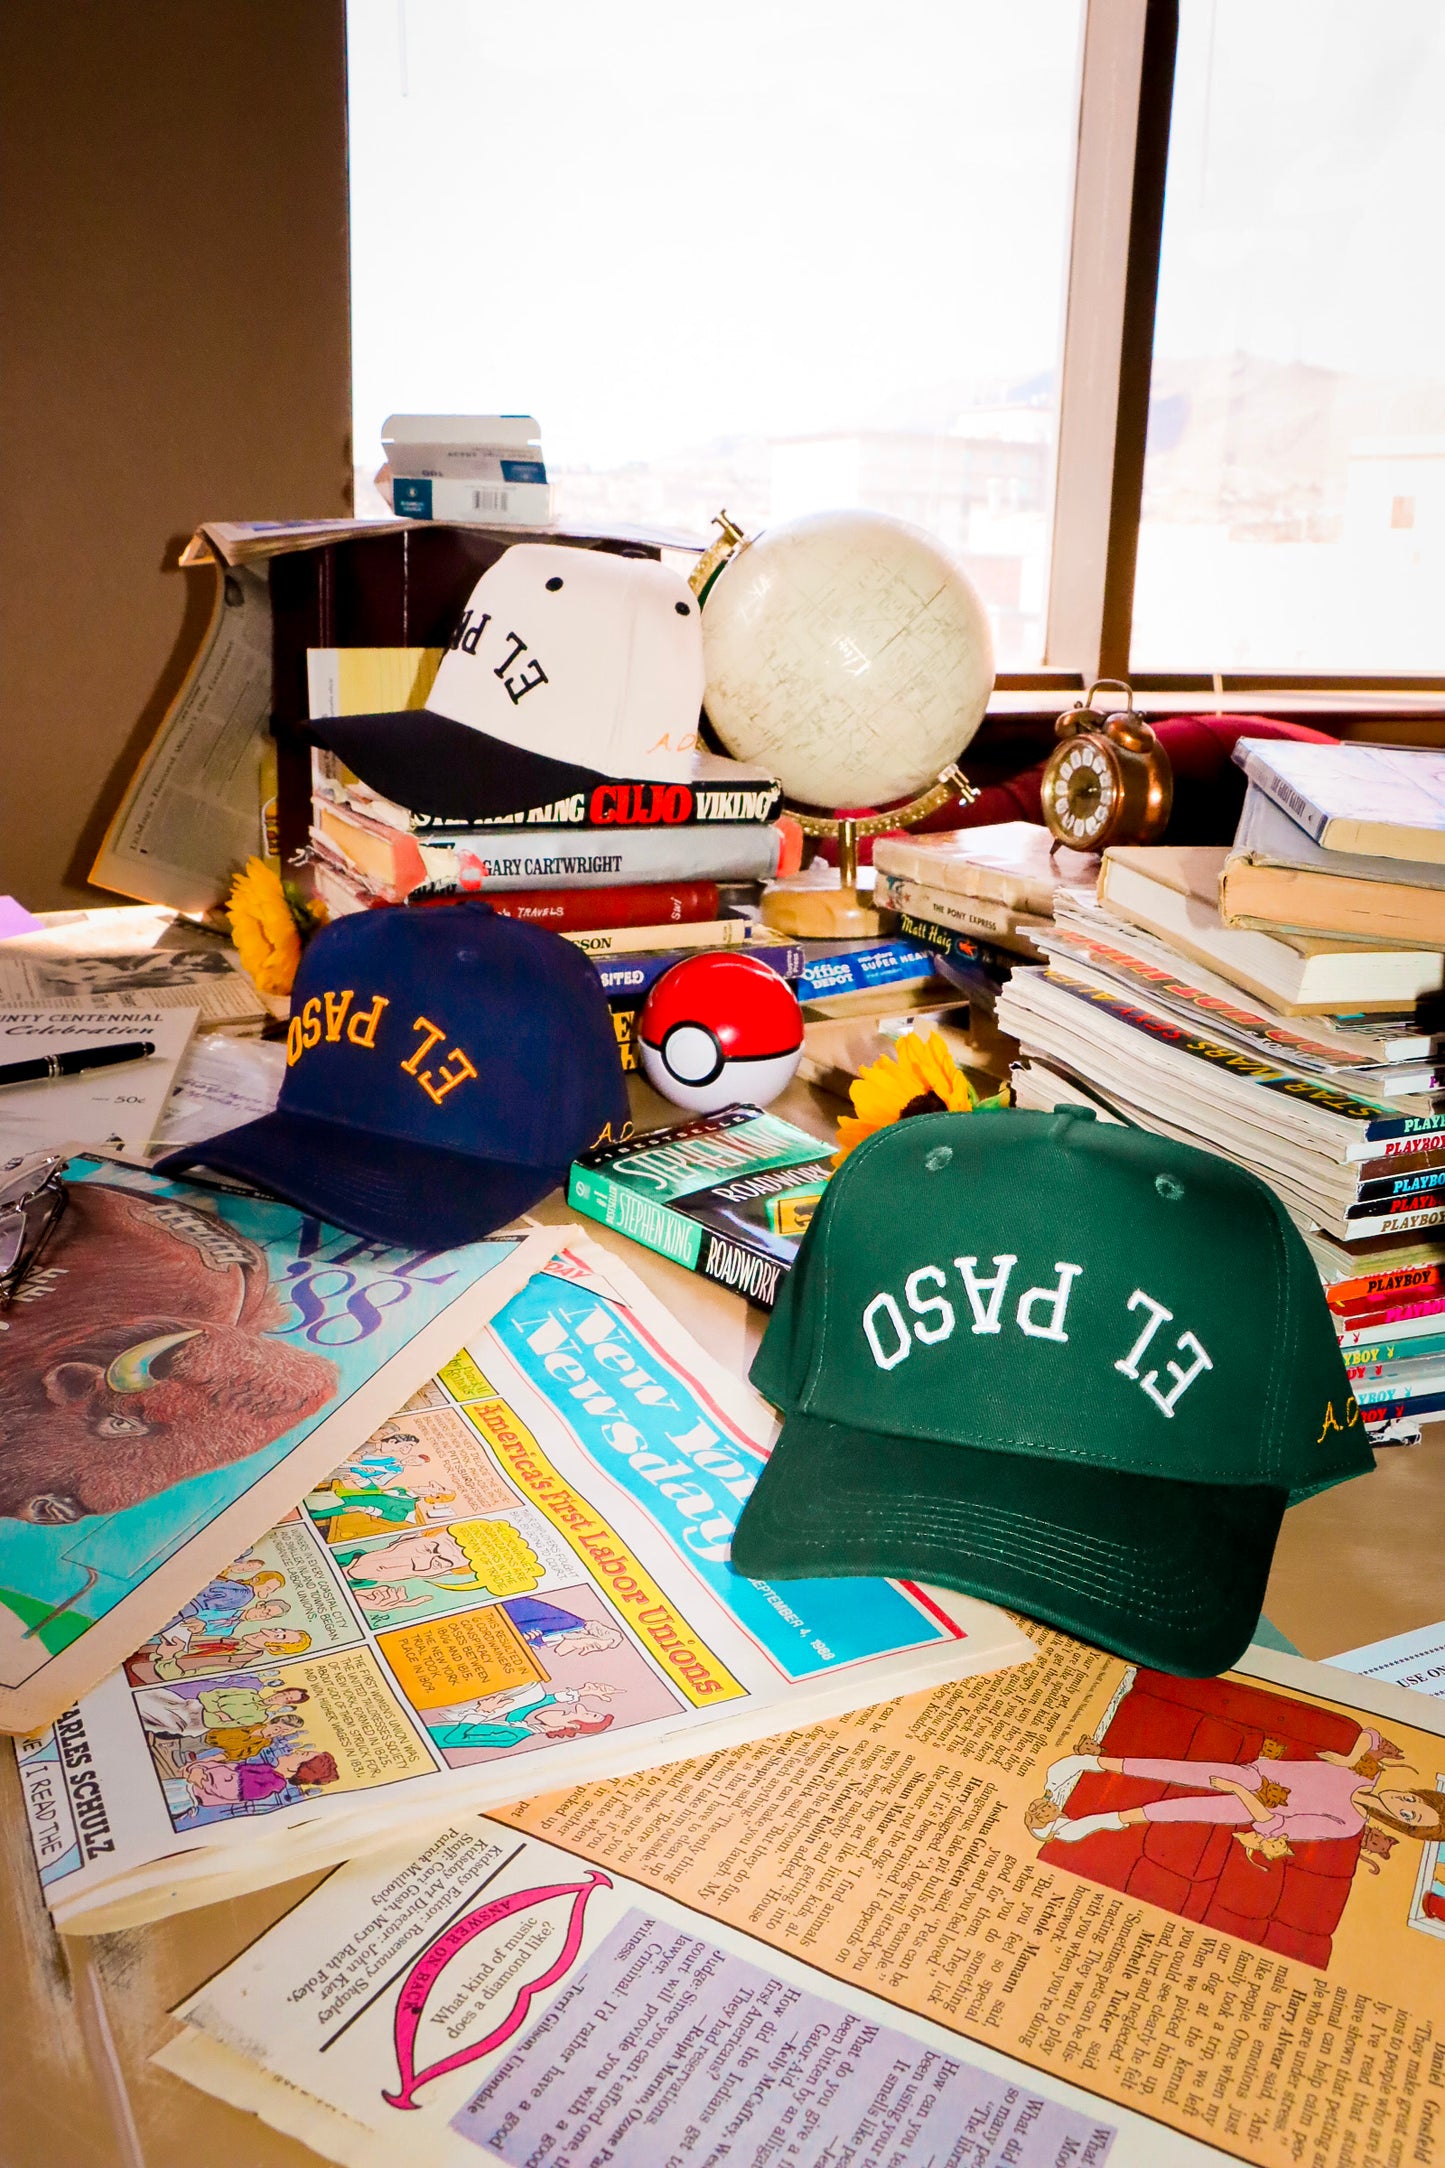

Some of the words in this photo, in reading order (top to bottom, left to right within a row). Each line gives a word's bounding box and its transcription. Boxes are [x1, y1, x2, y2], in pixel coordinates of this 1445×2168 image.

[494, 631, 549, 705] EL
[589, 784, 693, 825] CUJO
[695, 790, 772, 823] VIKING
[483, 857, 522, 876] GARY
[523, 855, 623, 877] CARTWRIGHT
[517, 906, 565, 919] TRAVELS
[933, 903, 945, 915] THE
[947, 908, 967, 921] PONY
[969, 914, 998, 931] EXPRESS
[901, 913, 927, 939] Matt
[928, 925, 953, 956] Haig
[800, 963, 851, 982] Office
[811, 972, 854, 990] DEPOT
[860, 957, 898, 972] SUPER
[5, 1024, 155, 1037] Celebration
[48, 1013, 164, 1023] CENTENNIAL
[287, 989, 391, 1068] PASO
[1111, 1005, 1194, 1040] SEXY
[401, 1015, 479, 1106] EL
[1186, 1040, 1285, 1083] WARS
[1283, 1081, 1381, 1119] STAR
[1404, 1115, 1445, 1134] PLAY
[613, 1134, 758, 1190] STEPHEN
[711, 1163, 834, 1203] ROADWORK
[1393, 1173, 1445, 1195] PLAYBO
[617, 1192, 664, 1245] STEPHEN
[662, 1221, 694, 1262] KING
[704, 1236, 781, 1306] ROADWORK
[1367, 1270, 1432, 1294] PLAYBOY
[862, 1253, 1084, 1372] PASO
[1112, 1288, 1214, 1420] EL
[1343, 1347, 1380, 1367] YBOY
[557, 1302, 682, 1412] New
[664, 1415, 759, 1506] Yor
[1358, 1387, 1398, 1406] YBOY
[510, 1310, 732, 1563] Newsday
[473, 1403, 554, 1494] America's
[539, 1488, 599, 1534] First
[577, 1529, 650, 1606] Labor
[637, 1603, 725, 1697] Unions
[397, 1637, 420, 1663] PLACE
[410, 1632, 427, 1656] TRIAL
[421, 1654, 442, 1679] TOOK
[422, 1629, 437, 1646] THE
[430, 1644, 448, 1664] NEW
[440, 1663, 460, 1686] YORK
[446, 1621, 468, 1646] CASES
[461, 1644, 491, 1684] BETWEEN
[459, 1618, 494, 1663] CONSPIRACY
[484, 1611, 500, 1630] THIS
[493, 1628, 523, 1666] RESULTED
[516, 1664, 529, 1675] IN
[810, 1638, 836, 1661] 1988
[411, 1662, 425, 1674] IN
[445, 1644, 463, 1662] AND
[455, 1661, 474, 1682] 1815.
[1395, 1672, 1429, 1689] USE
[416, 1673, 436, 1694] 1809.
[57, 1708, 93, 1770] ARLES
[29, 1778, 57, 1823] READ
[69, 1769, 116, 1862] SCHULZ
[38, 1821, 63, 1857] THE
[417, 1826, 459, 1863] Patrick
[440, 1832, 474, 1861] Staff:
[415, 1860, 445, 1885] Cari
[441, 1837, 489, 1880] Kidsday
[456, 1844, 503, 1886] Kidsday
[370, 1861, 423, 1906] Mullooly
[382, 1883, 420, 1912] Gash,
[423, 1877, 445, 1899] Art
[376, 1896, 429, 1944] Director:
[419, 1885, 462, 1923] Editor:
[1032, 1891, 1065, 1936] Nichole
[1084, 1892, 1105, 1917] with
[1090, 1898, 1124, 1944] tracting.
[352, 1913, 389, 1944] Mary
[446, 1900, 511, 1945] ANSWER
[1073, 1914, 1092, 1940] you
[324, 1942, 358, 1969] Beth
[345, 1942, 379, 1973] John
[364, 1922, 424, 1978] Rosemary
[427, 1946, 447, 1967] ON
[1001, 1940, 1040, 1993] Mamann
[1057, 1941, 1081, 1972] when
[1075, 1948, 1103, 1979] They
[1121, 1928, 1155, 1980] Michelle
[286, 1968, 329, 2003] Foley,
[320, 1971, 350, 2000] Kier
[429, 1992, 469, 2024] What
[460, 1961, 495, 1993] kind
[490, 1946, 507, 1964] of
[503, 1916, 538, 1951] music
[445, 2009, 477, 2039] does
[473, 2000, 487, 2011] a
[481, 1947, 532, 2000] diamond
[523, 1920, 555, 1951] like?
[1089, 1971, 1110, 2000] pets
[317, 1977, 369, 2025] Skapley
[402, 1972, 431, 2011] BACK
[721, 1986, 755, 2019] They
[1061, 1980, 1085, 2011] want
[980, 1998, 1005, 2028] said,
[1054, 2011, 1072, 2026] to
[1078, 1999, 1097, 2022] can
[1098, 1988, 1129, 2033] Tucker
[703, 2017, 732, 2047] had
[1018, 2011, 1048, 2048] doing
[1037, 2025, 1062, 2056] play
[1070, 2022, 1092, 2040] be
[1061, 2039, 1082, 2063] dis-
[1078, 2040, 1101, 2070] said,
[642, 2044, 709, 2125] reservations.
